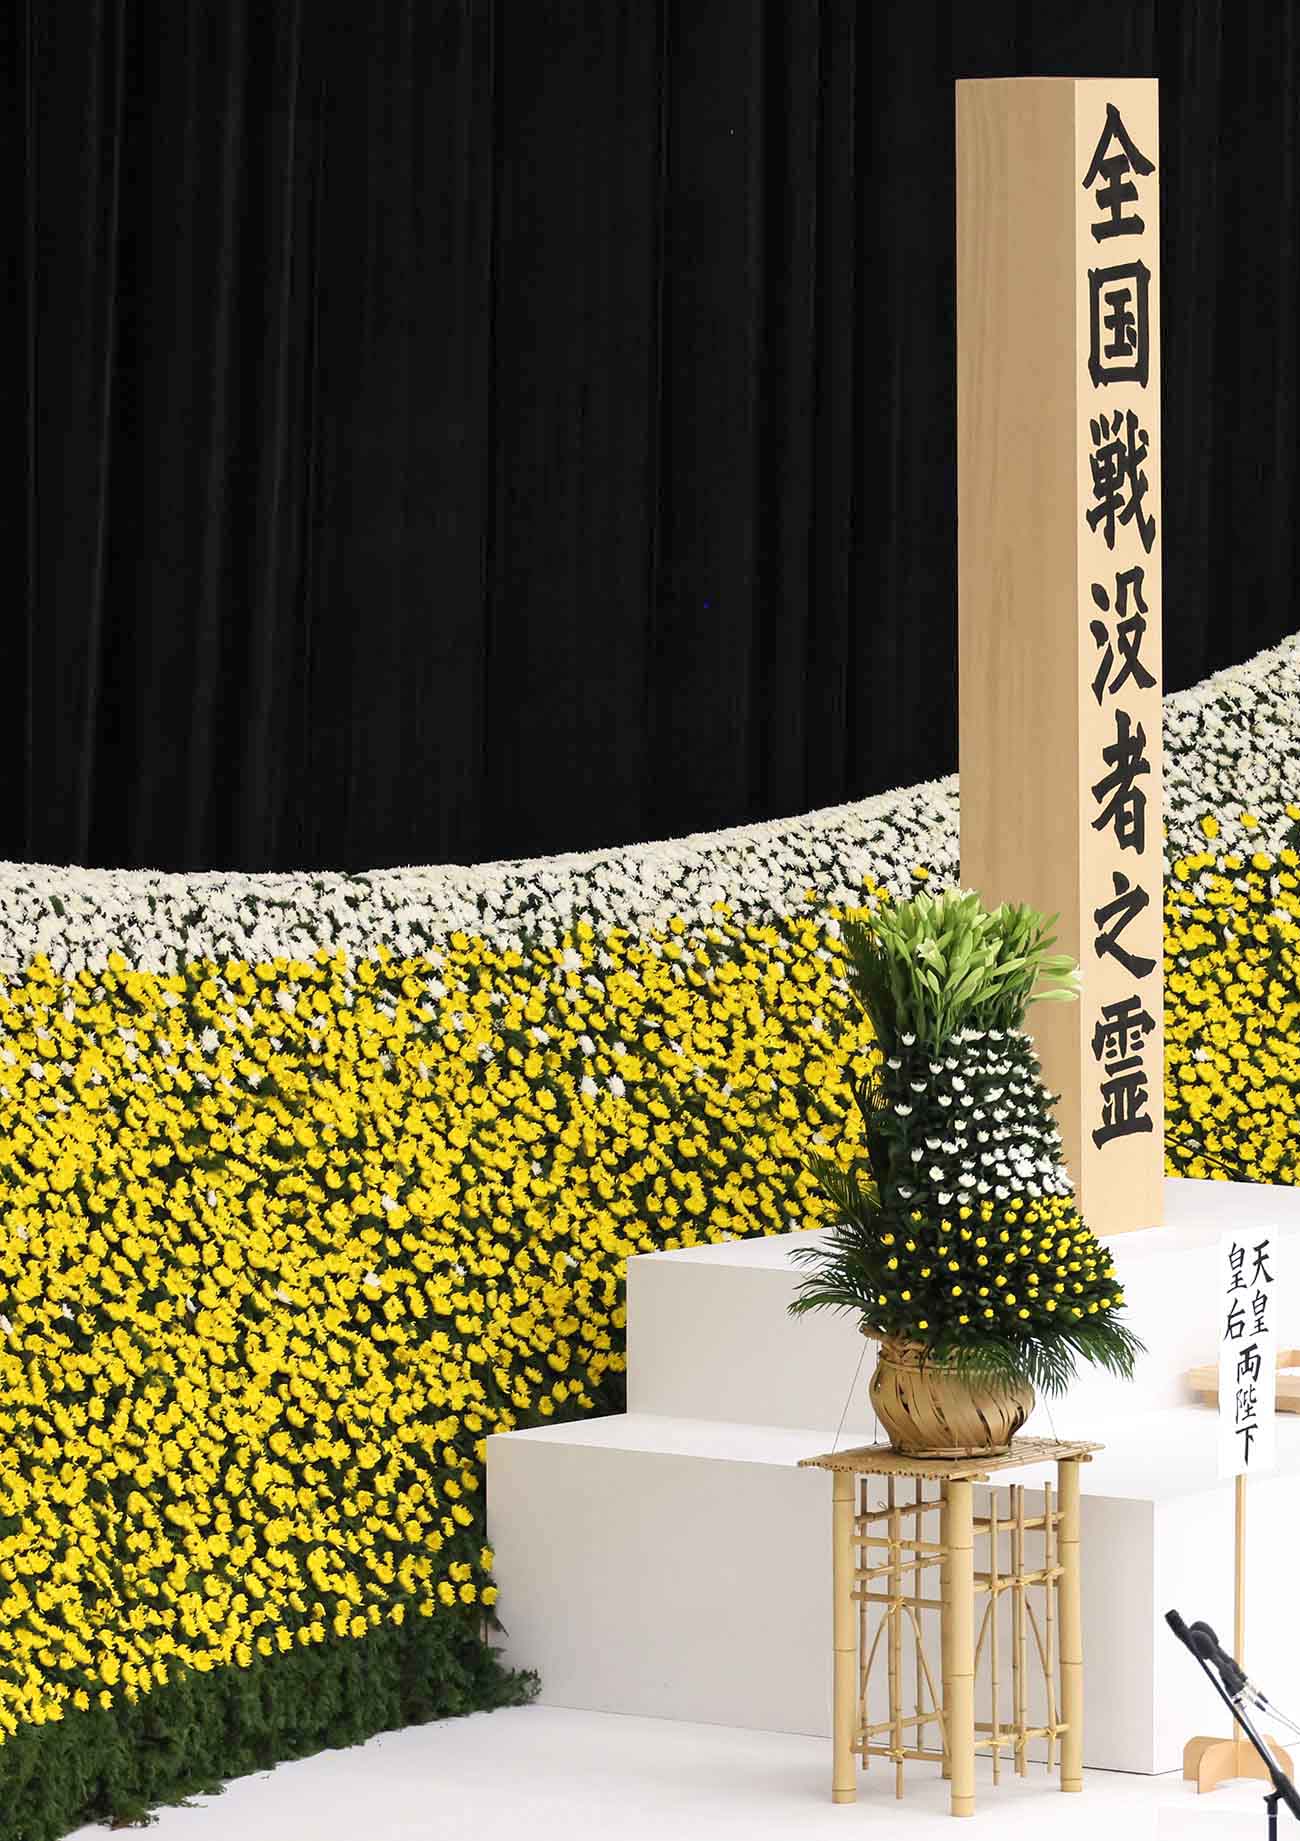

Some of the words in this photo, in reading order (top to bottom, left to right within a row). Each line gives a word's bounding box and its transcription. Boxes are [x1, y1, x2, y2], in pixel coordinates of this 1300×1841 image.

[1080, 102, 1157, 1151] 全国戦没者之霊
[1223, 1242, 1248, 1341] 皇后
[1250, 1239, 1275, 1337] 天皇
[1235, 1343, 1262, 1466] 両陛下
